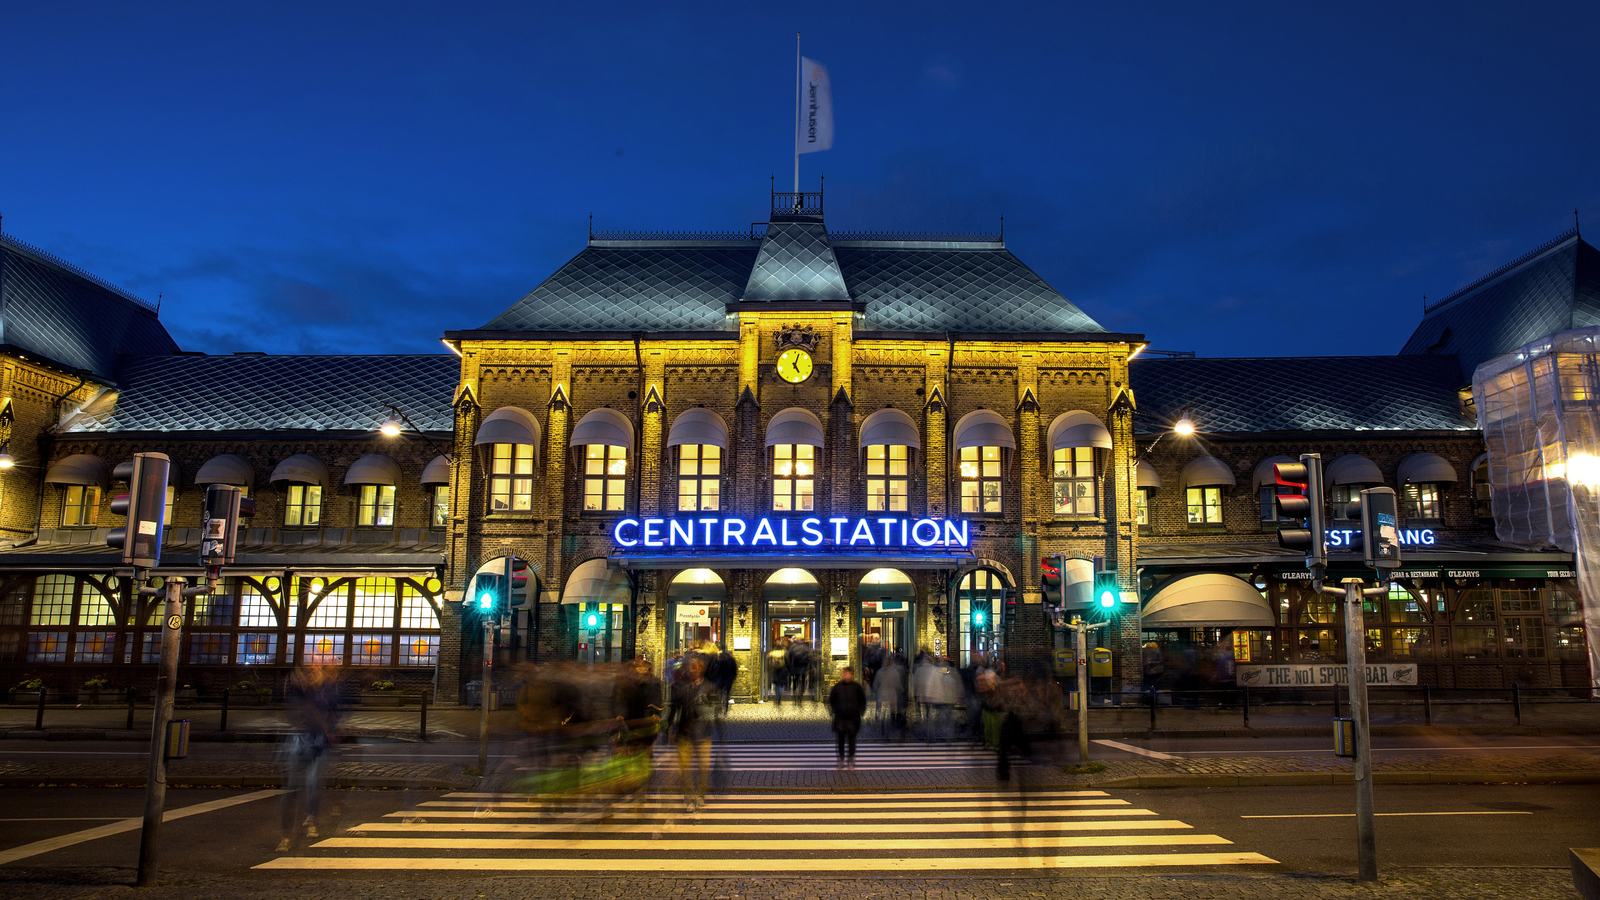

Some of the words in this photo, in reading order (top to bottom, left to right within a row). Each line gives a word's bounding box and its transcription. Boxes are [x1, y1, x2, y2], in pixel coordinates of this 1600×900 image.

[807, 81, 818, 143] Jernhusen
[613, 517, 970, 547] CENTRALSTATION
[1448, 570, 1480, 578] O'LEARYS
[1266, 667, 1291, 684] THE
[1320, 667, 1349, 684] SPOR
[1366, 667, 1388, 684] BAR
